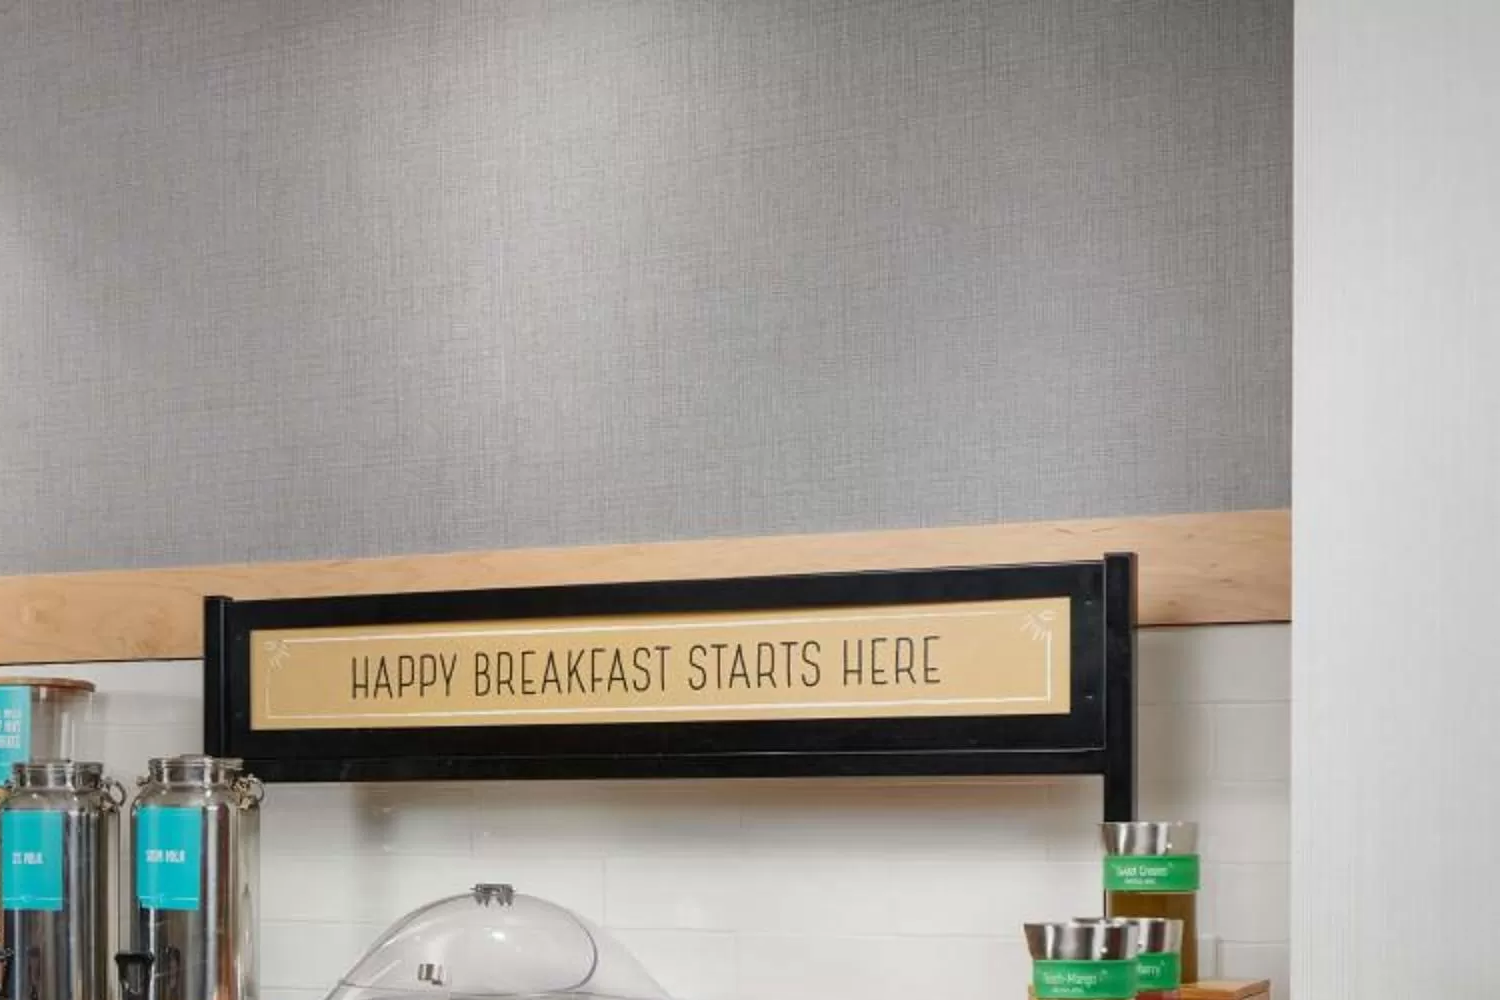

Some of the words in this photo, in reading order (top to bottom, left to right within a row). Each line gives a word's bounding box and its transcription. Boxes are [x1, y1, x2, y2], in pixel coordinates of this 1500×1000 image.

[351, 652, 457, 698] HAPPY
[474, 645, 672, 696] BREAKFAST
[688, 640, 821, 691] STARTS
[843, 635, 941, 686] HERE
